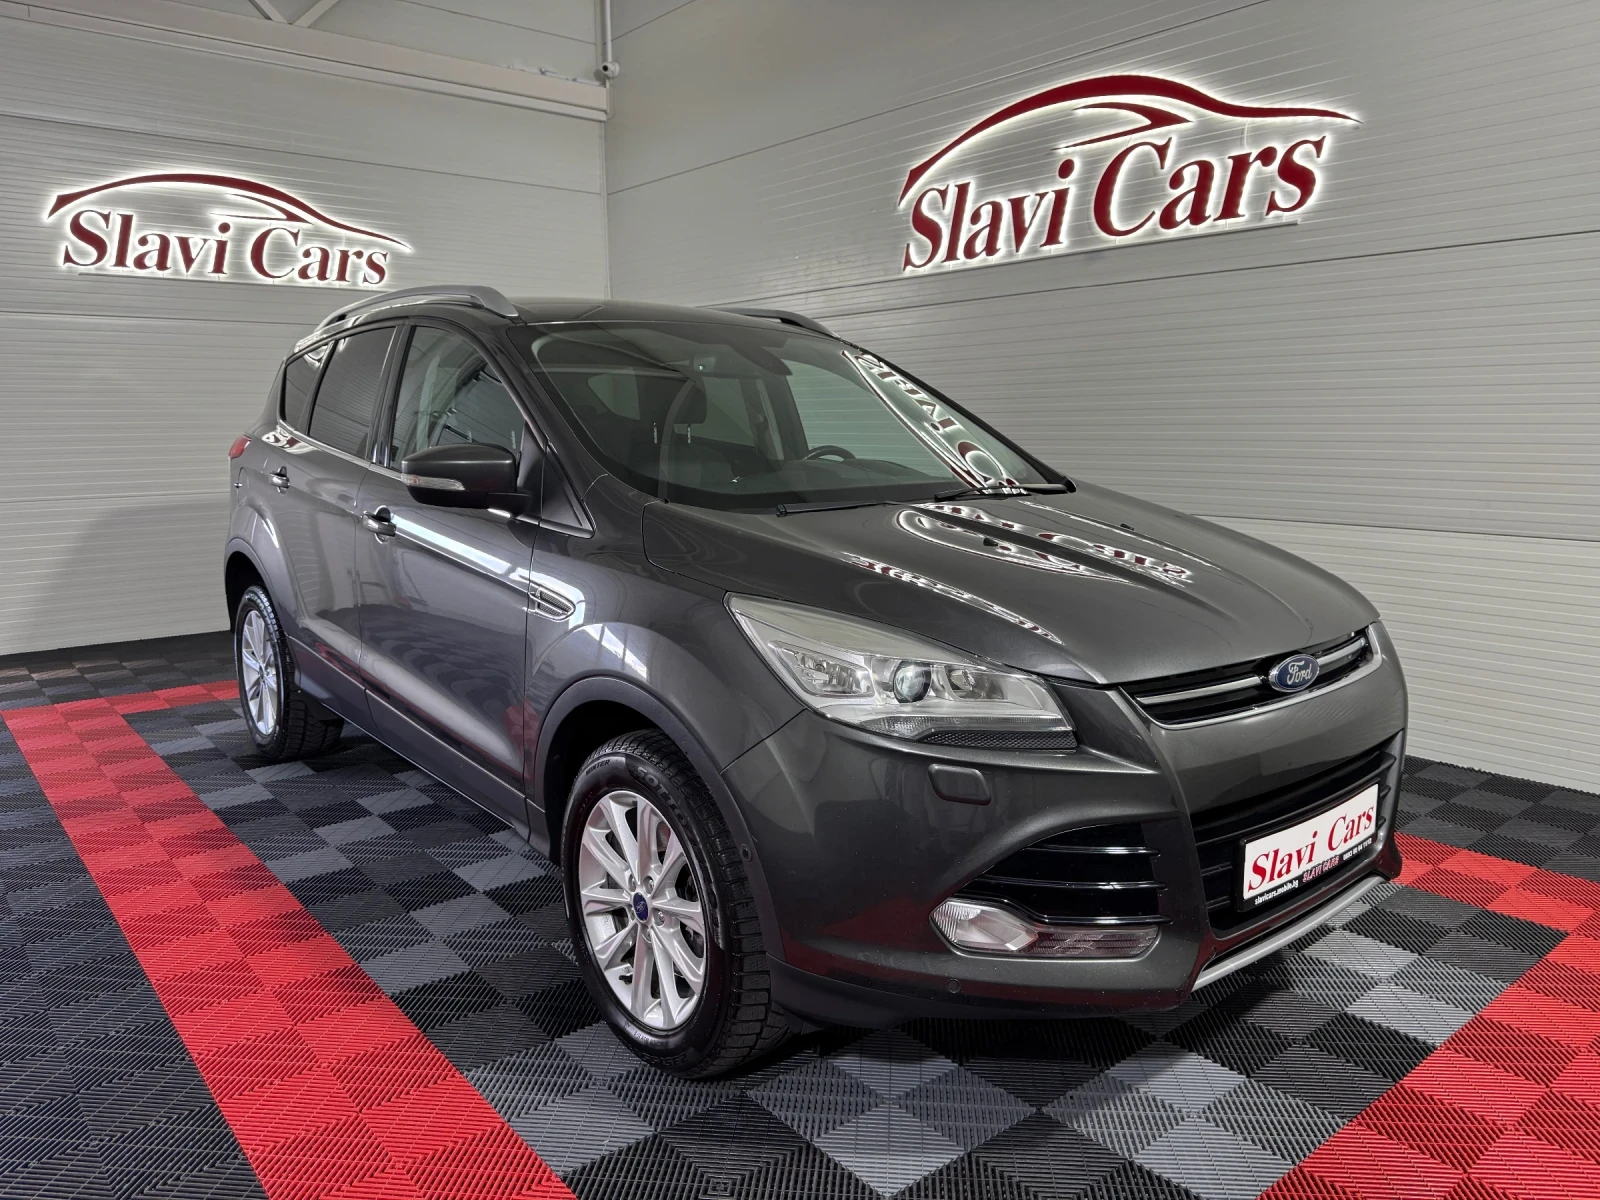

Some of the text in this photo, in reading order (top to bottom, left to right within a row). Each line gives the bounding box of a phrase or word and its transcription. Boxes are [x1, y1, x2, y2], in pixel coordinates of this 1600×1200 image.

[902, 135, 1328, 272] Slavi Cars
[63, 209, 390, 285] Slavi Cars
[1286, 660, 1313, 686] Ford
[1247, 806, 1374, 893] Slavi Cars
[1254, 879, 1299, 906] slavicars.mobile.bg
